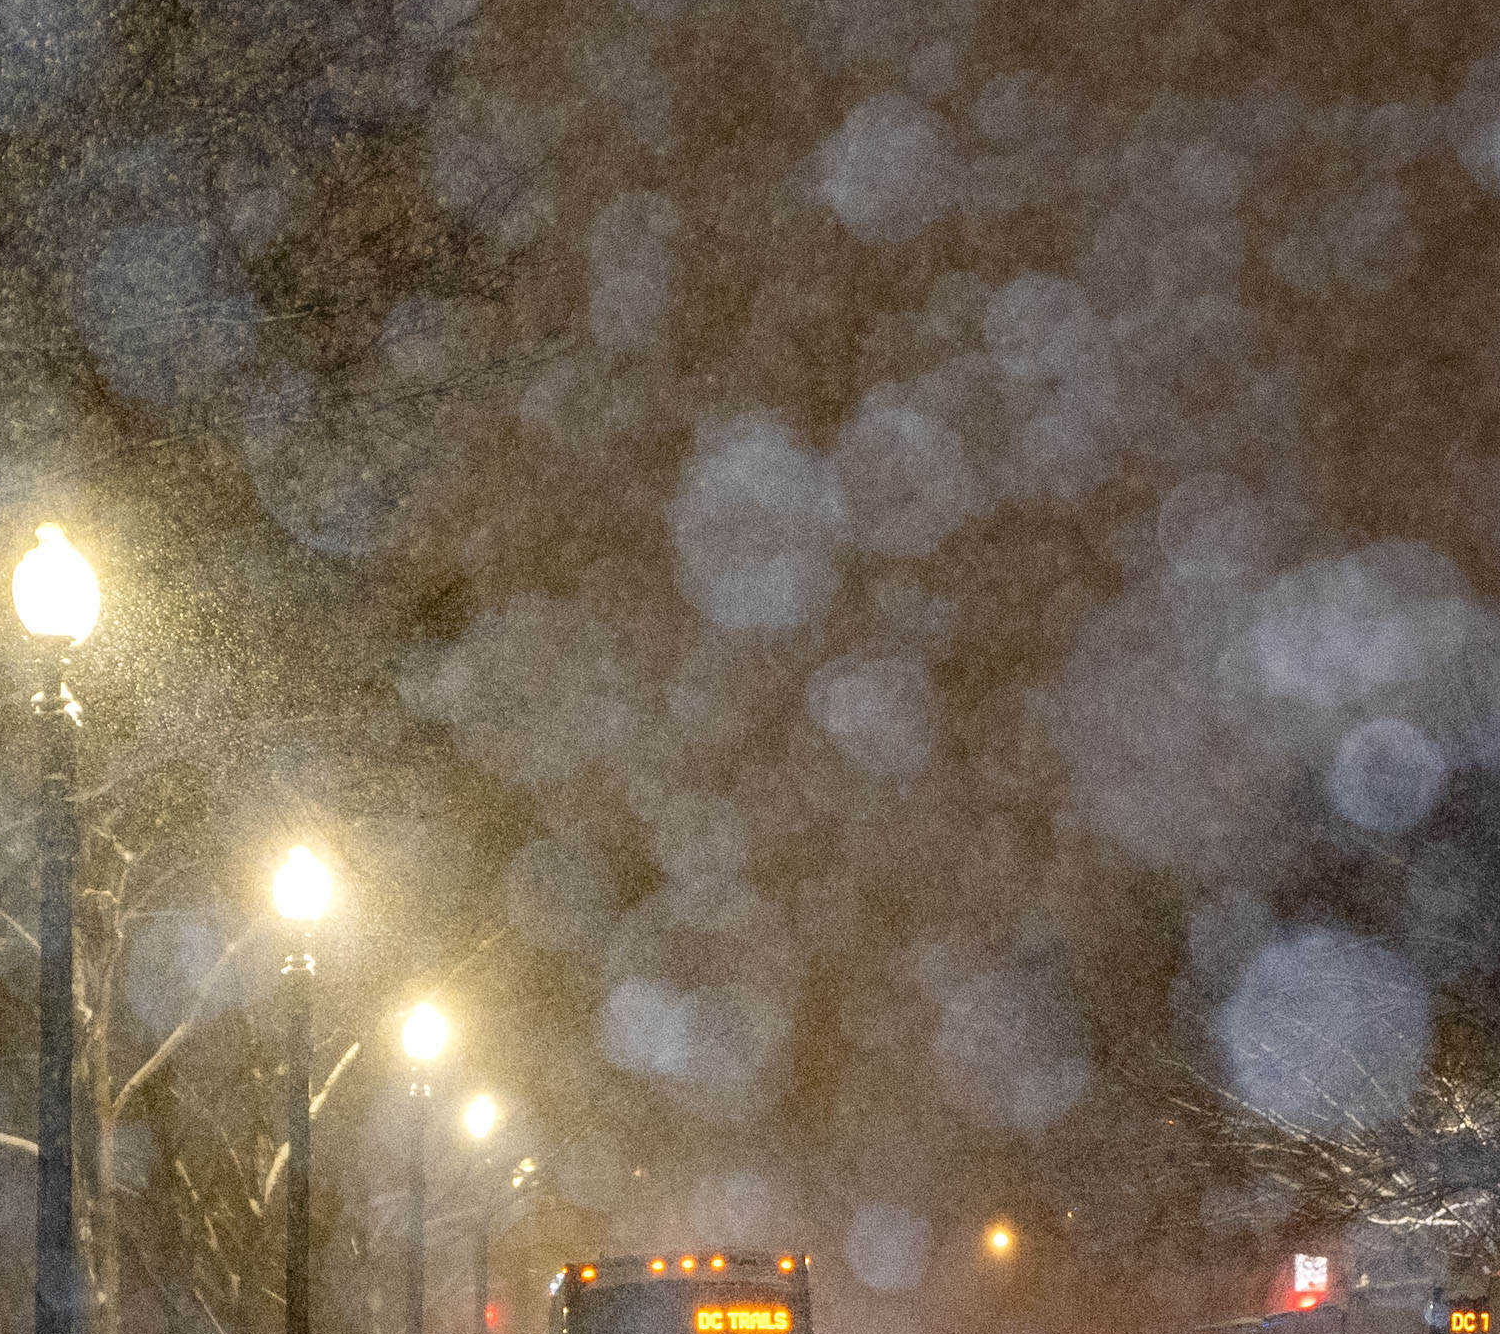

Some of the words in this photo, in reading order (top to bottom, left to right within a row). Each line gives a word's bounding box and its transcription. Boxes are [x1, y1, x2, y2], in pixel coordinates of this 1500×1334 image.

[697, 1311, 723, 1330] DC
[726, 1311, 789, 1330] TRAILS
[1450, 1311, 1477, 1333] DC
